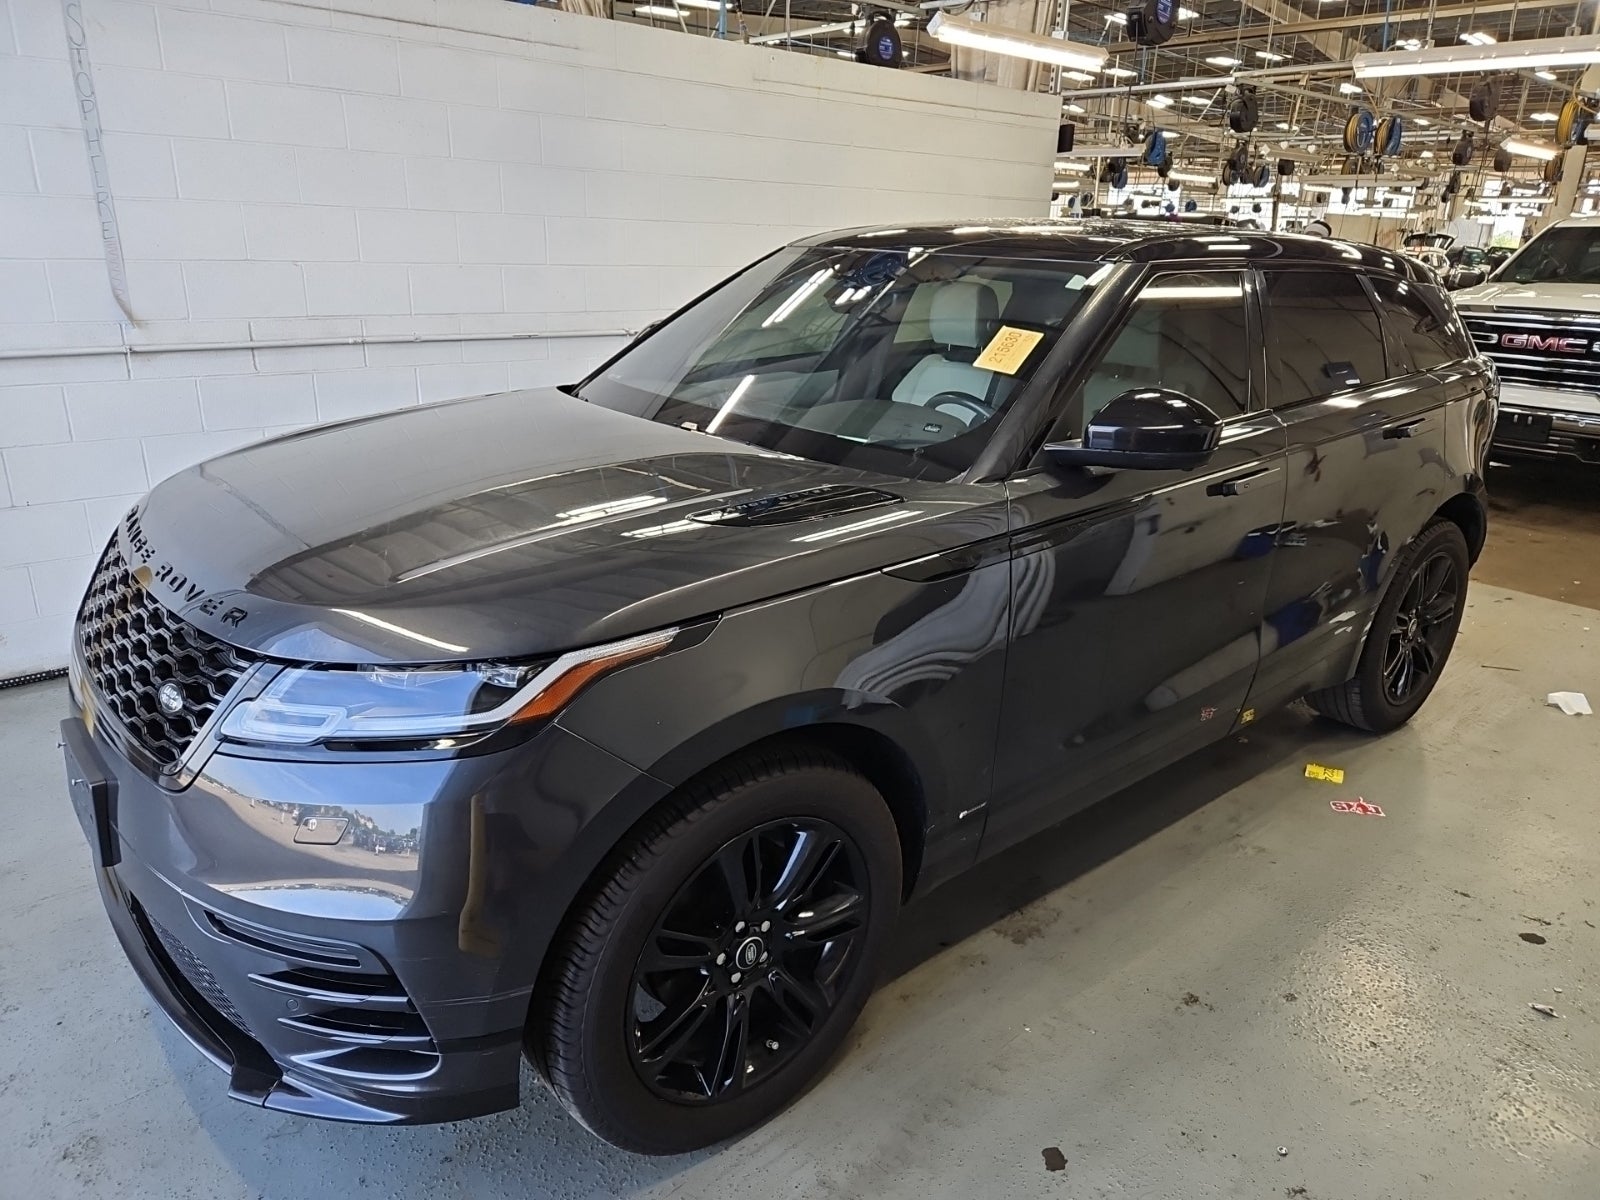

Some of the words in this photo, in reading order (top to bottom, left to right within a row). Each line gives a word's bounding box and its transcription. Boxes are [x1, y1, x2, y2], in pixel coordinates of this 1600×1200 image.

[66, 3, 96, 120] STOP
[86, 127, 117, 240] HERE
[1501, 333, 1588, 354] GMC
[155, 561, 248, 628] ROVER
